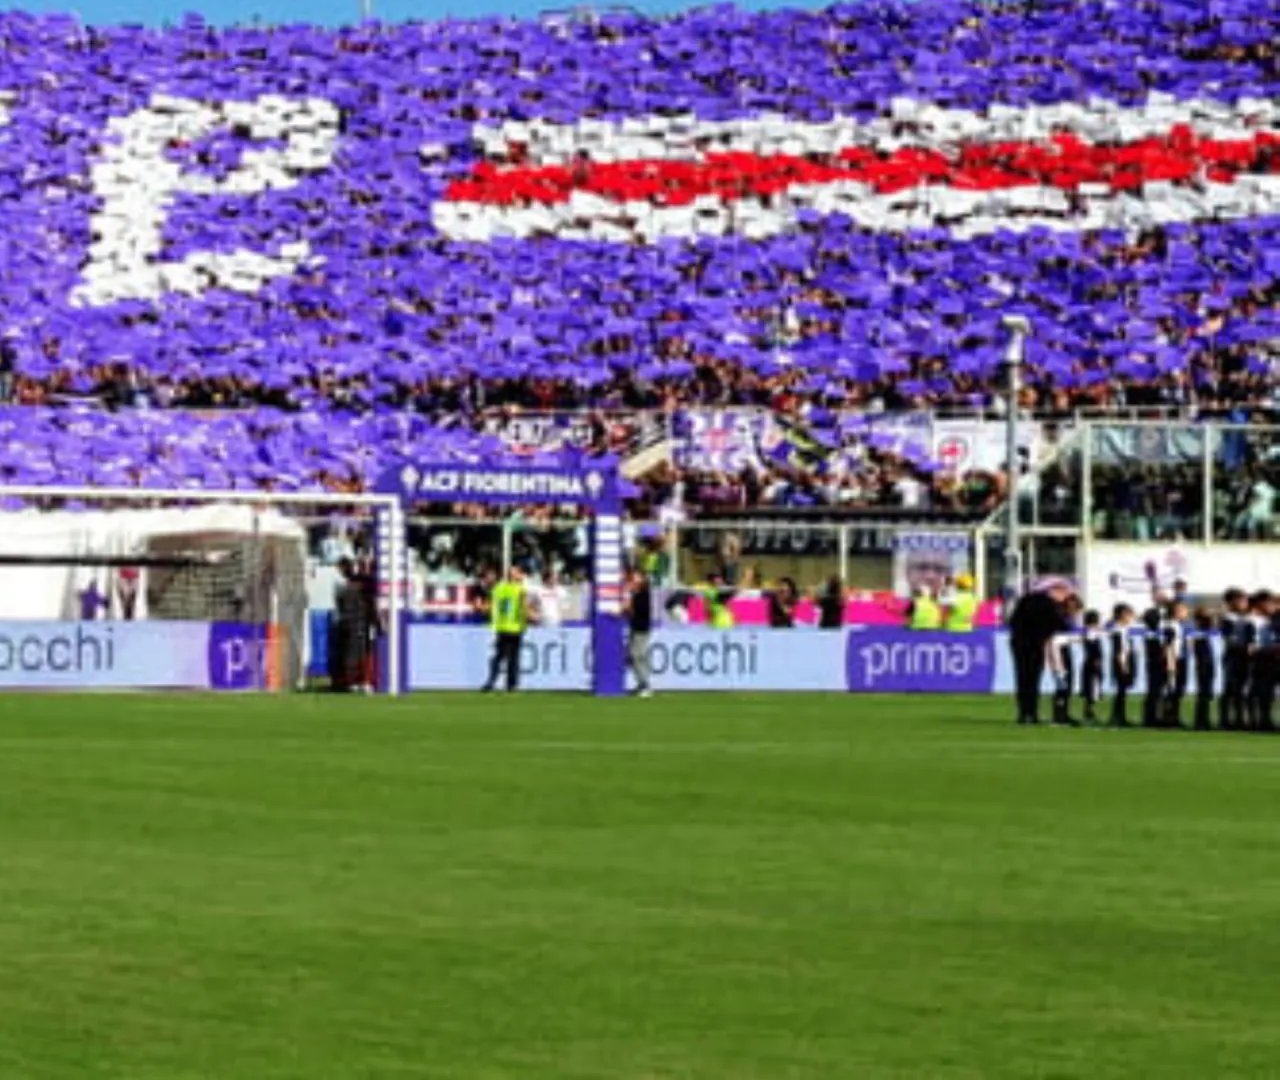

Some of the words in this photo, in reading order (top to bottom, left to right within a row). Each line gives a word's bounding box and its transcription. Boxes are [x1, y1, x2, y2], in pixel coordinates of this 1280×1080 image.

[419, 470, 458, 491] ACF
[463, 471, 583, 496] FIORENTINA
[645, 633, 759, 676] occhi
